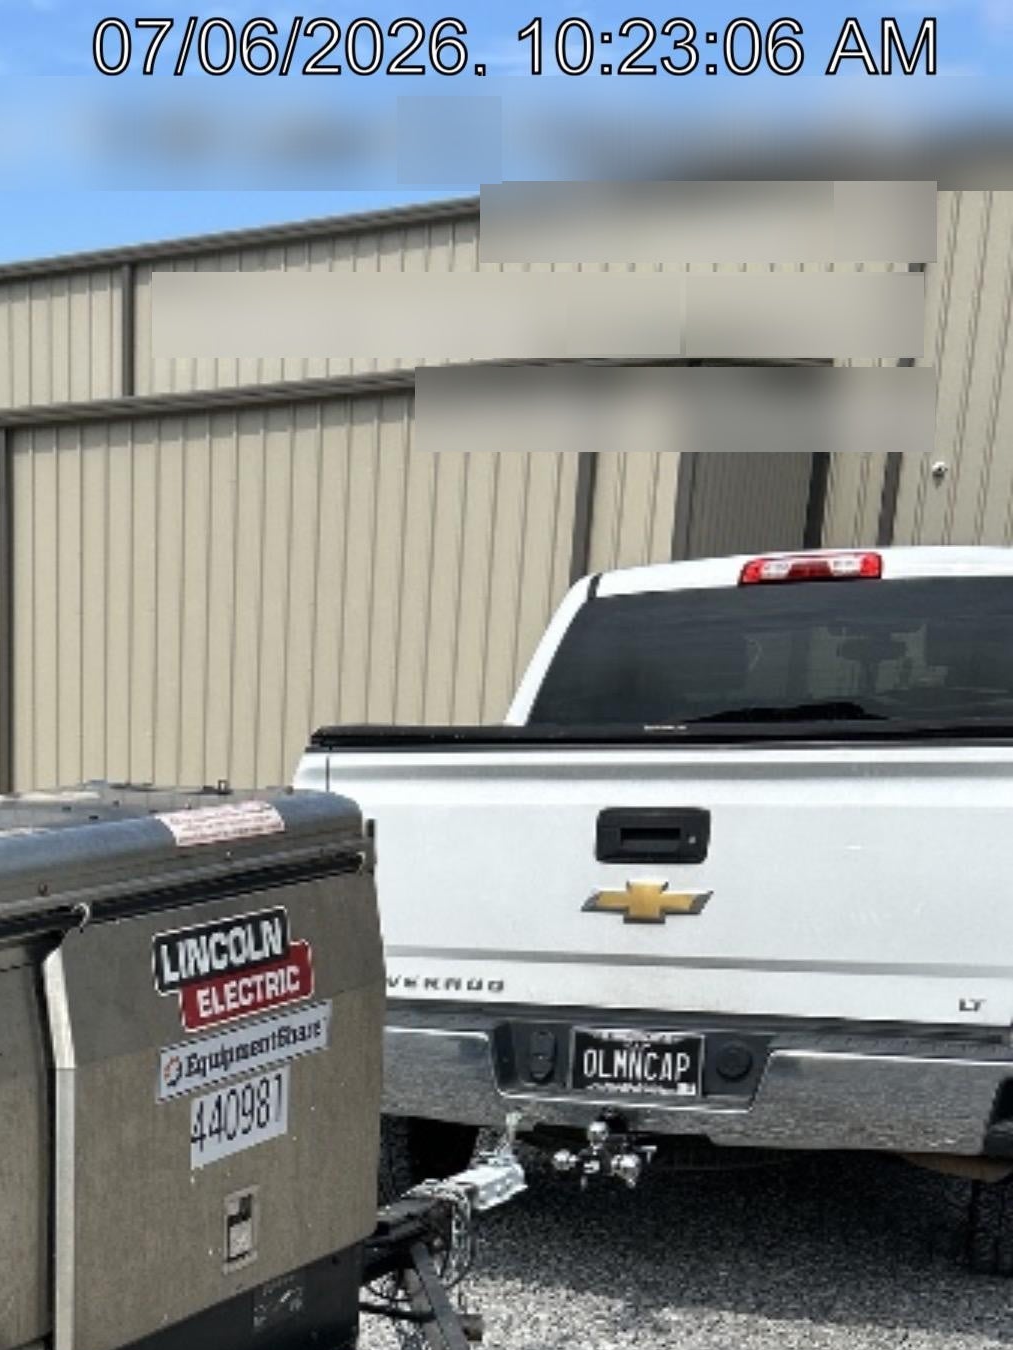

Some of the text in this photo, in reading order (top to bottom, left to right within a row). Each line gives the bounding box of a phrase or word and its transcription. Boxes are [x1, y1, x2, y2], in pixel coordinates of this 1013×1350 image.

[160, 917, 282, 984] LINCOLN
[196, 965, 300, 1018] ELECTRIC
[959, 998, 987, 1012] LT
[190, 1072, 283, 1153] 440981
